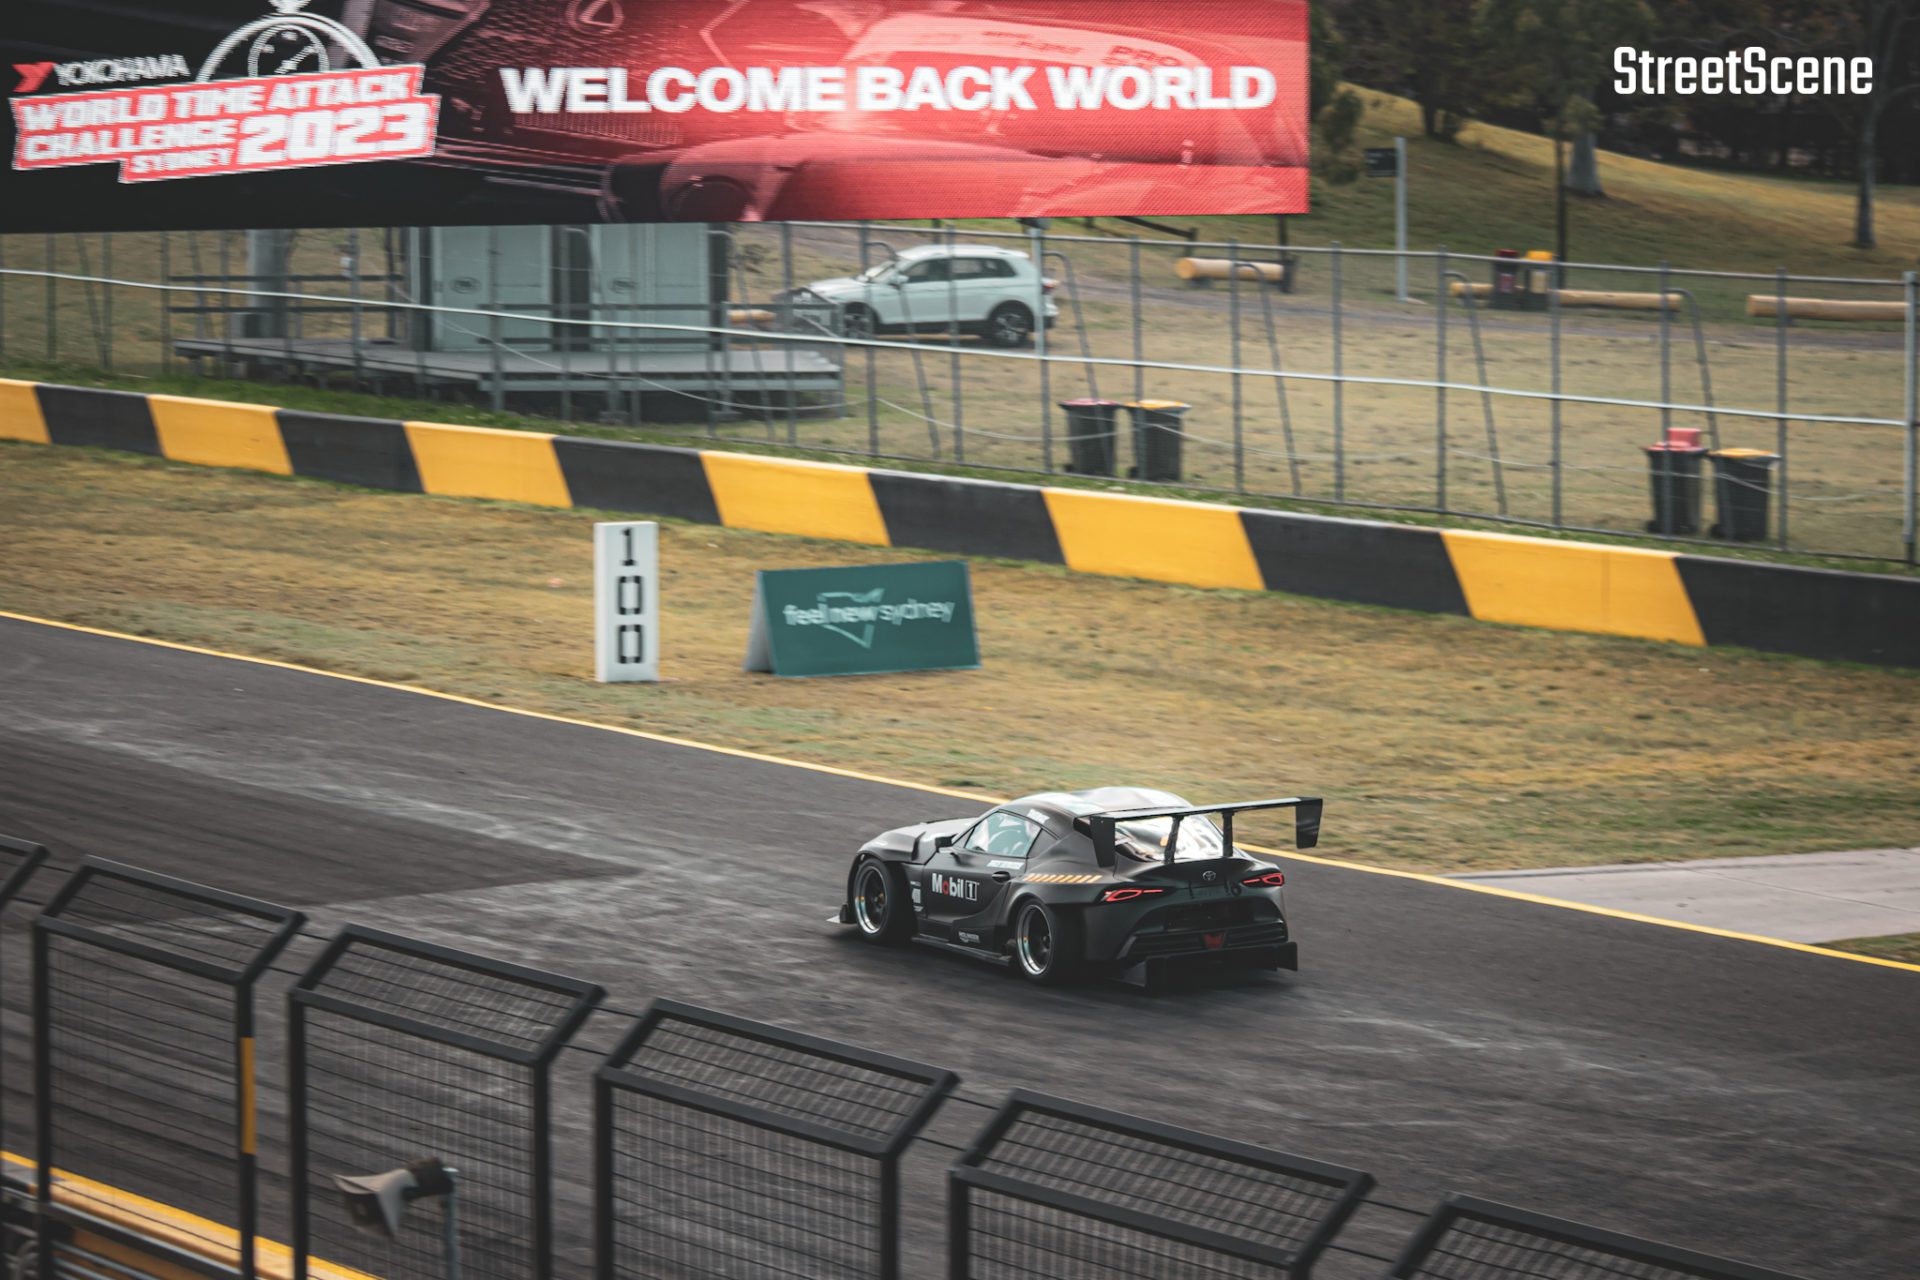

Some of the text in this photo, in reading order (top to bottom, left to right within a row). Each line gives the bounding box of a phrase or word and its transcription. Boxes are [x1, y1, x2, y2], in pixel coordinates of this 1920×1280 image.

[55, 54, 190, 86] YOKOHAMA
[21, 72, 410, 131] WORLD TIME ATTACK
[500, 65, 1277, 114] WELCOME BACK WORLD
[23, 119, 237, 161] CHALLENGE
[238, 102, 429, 165] 2023
[130, 148, 232, 174] SYDNEY
[782, 597, 955, 626] feel new sydney
[931, 872, 964, 899] Mobil
